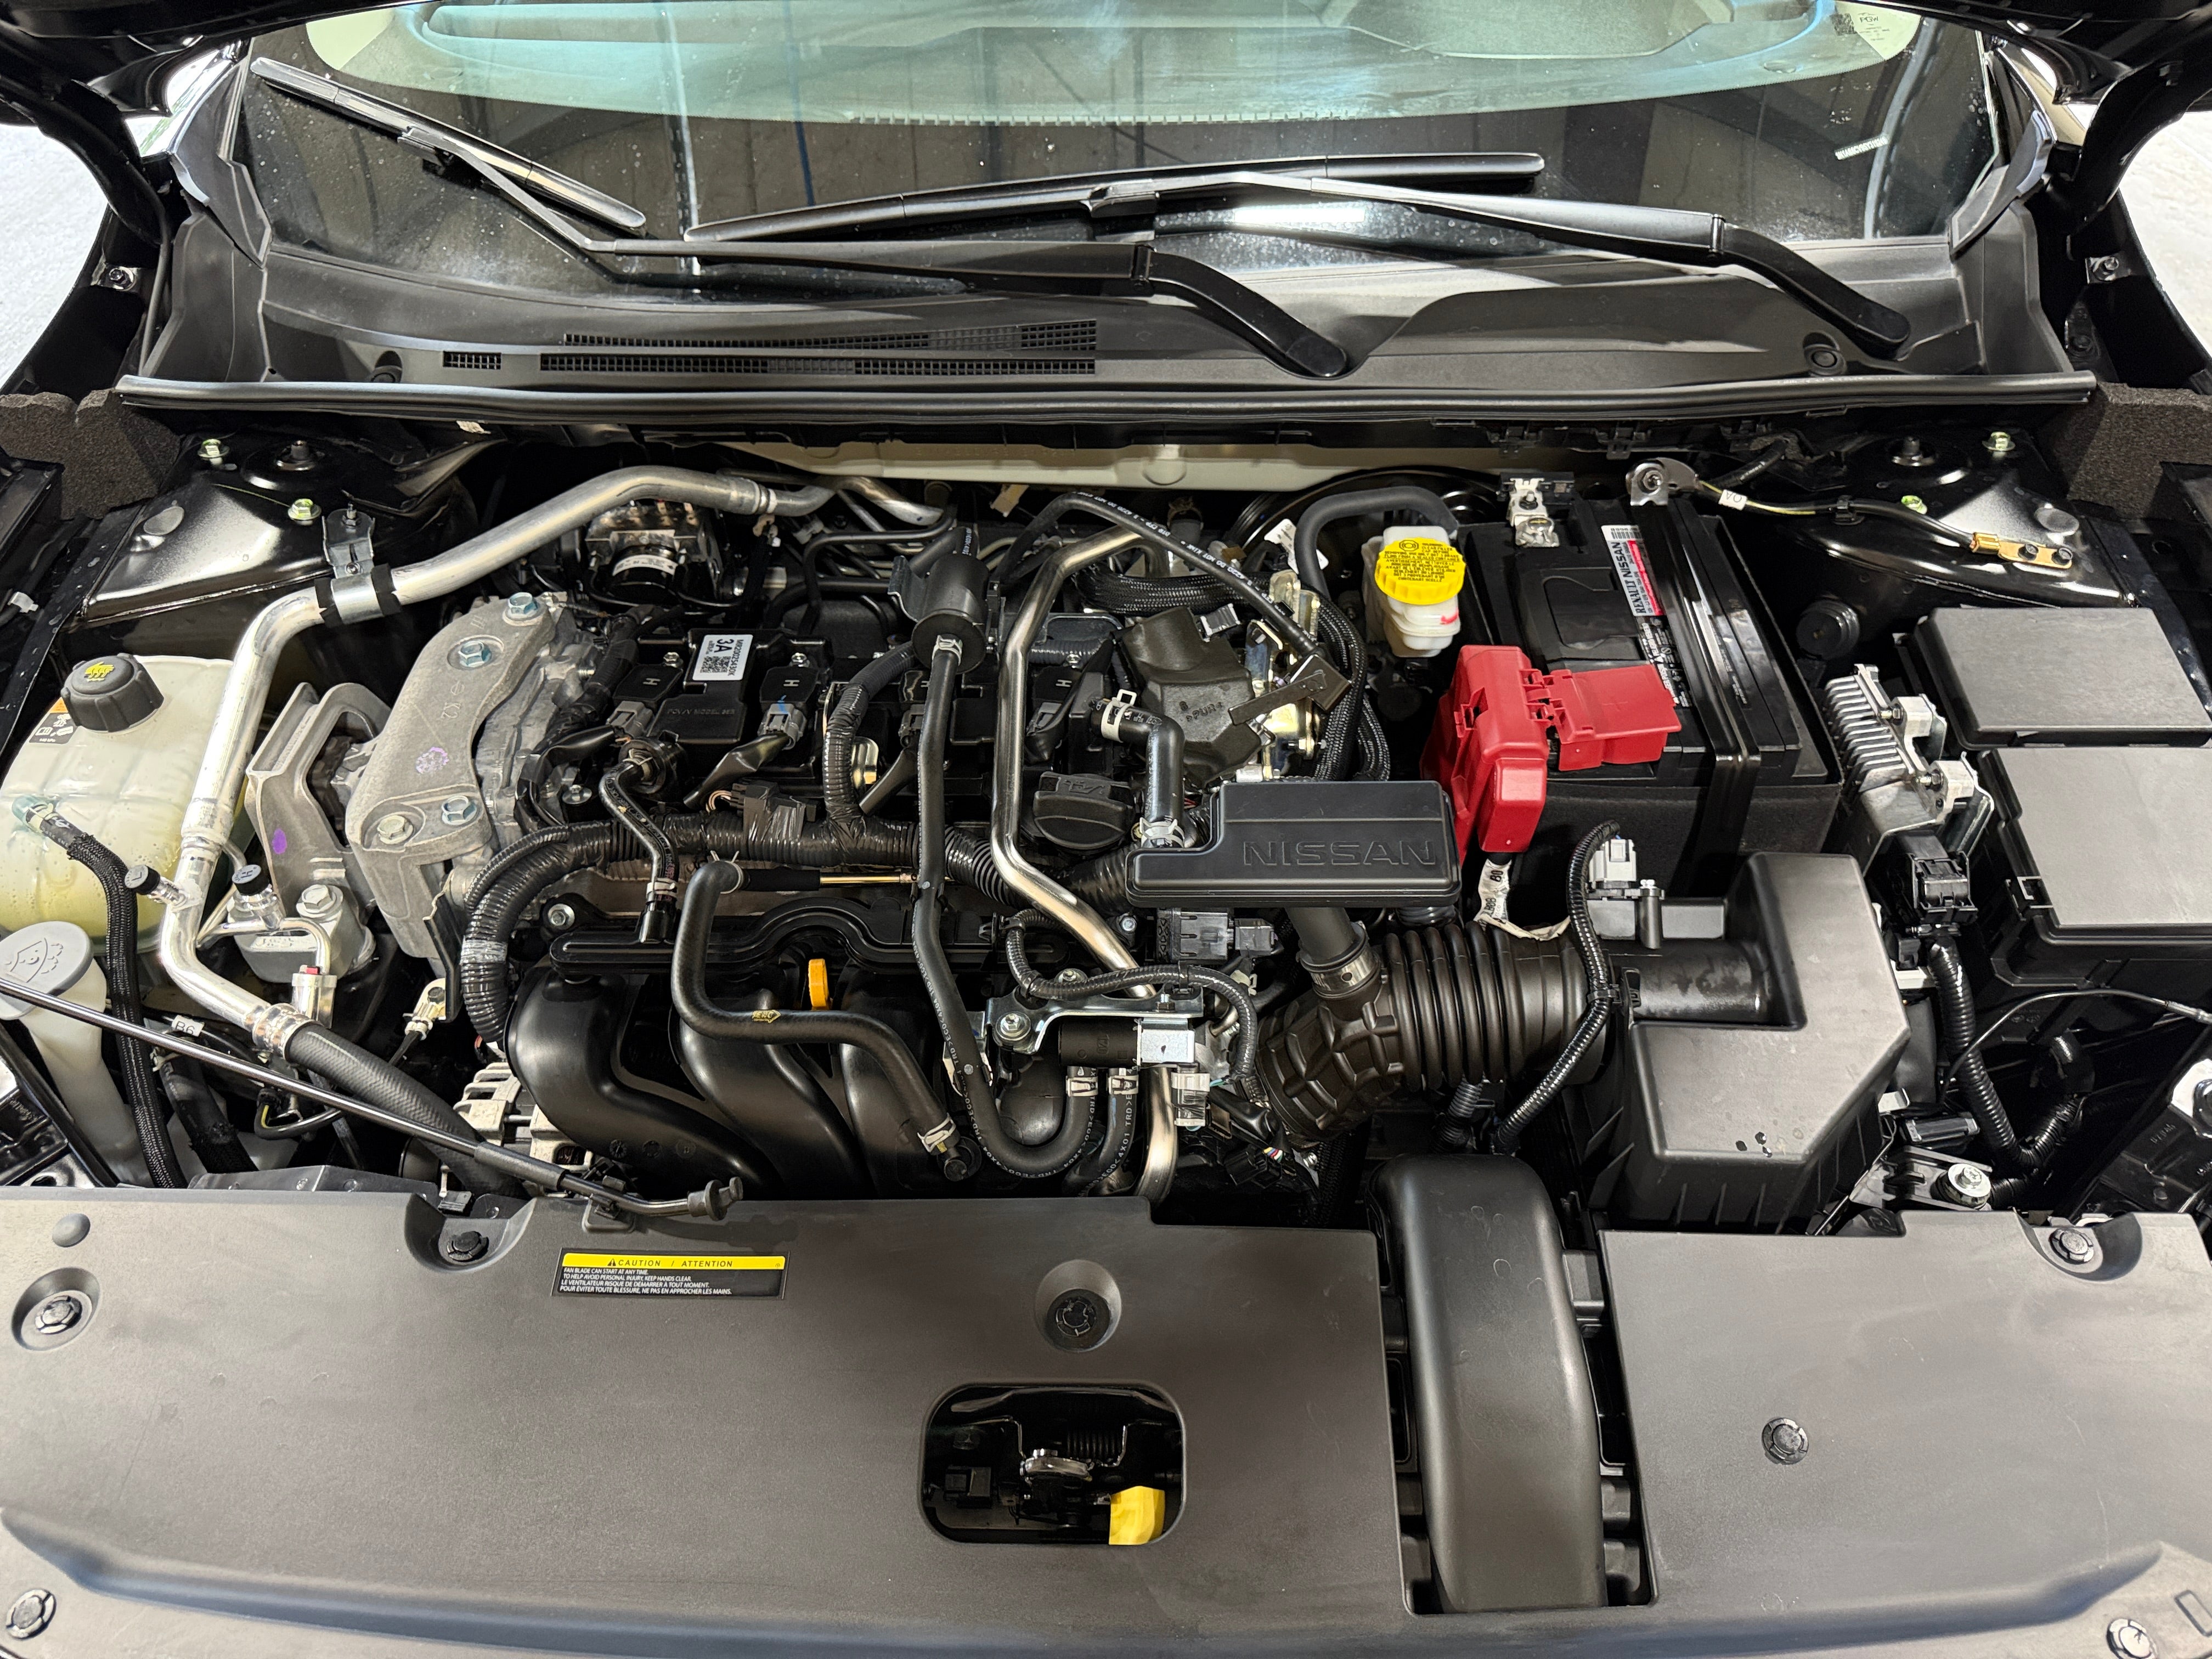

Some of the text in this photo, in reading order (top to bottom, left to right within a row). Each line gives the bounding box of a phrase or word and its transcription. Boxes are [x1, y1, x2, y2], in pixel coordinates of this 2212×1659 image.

[1203, 553, 1216, 562] NOT
[1216, 560, 1226, 568] DO
[1611, 542, 1633, 578] NISSAN
[1624, 580, 1646, 613] RENAULT
[714, 639, 734, 653] 3A
[1243, 840, 1436, 866] NISSAN
[176, 1021, 195, 1035] B6
